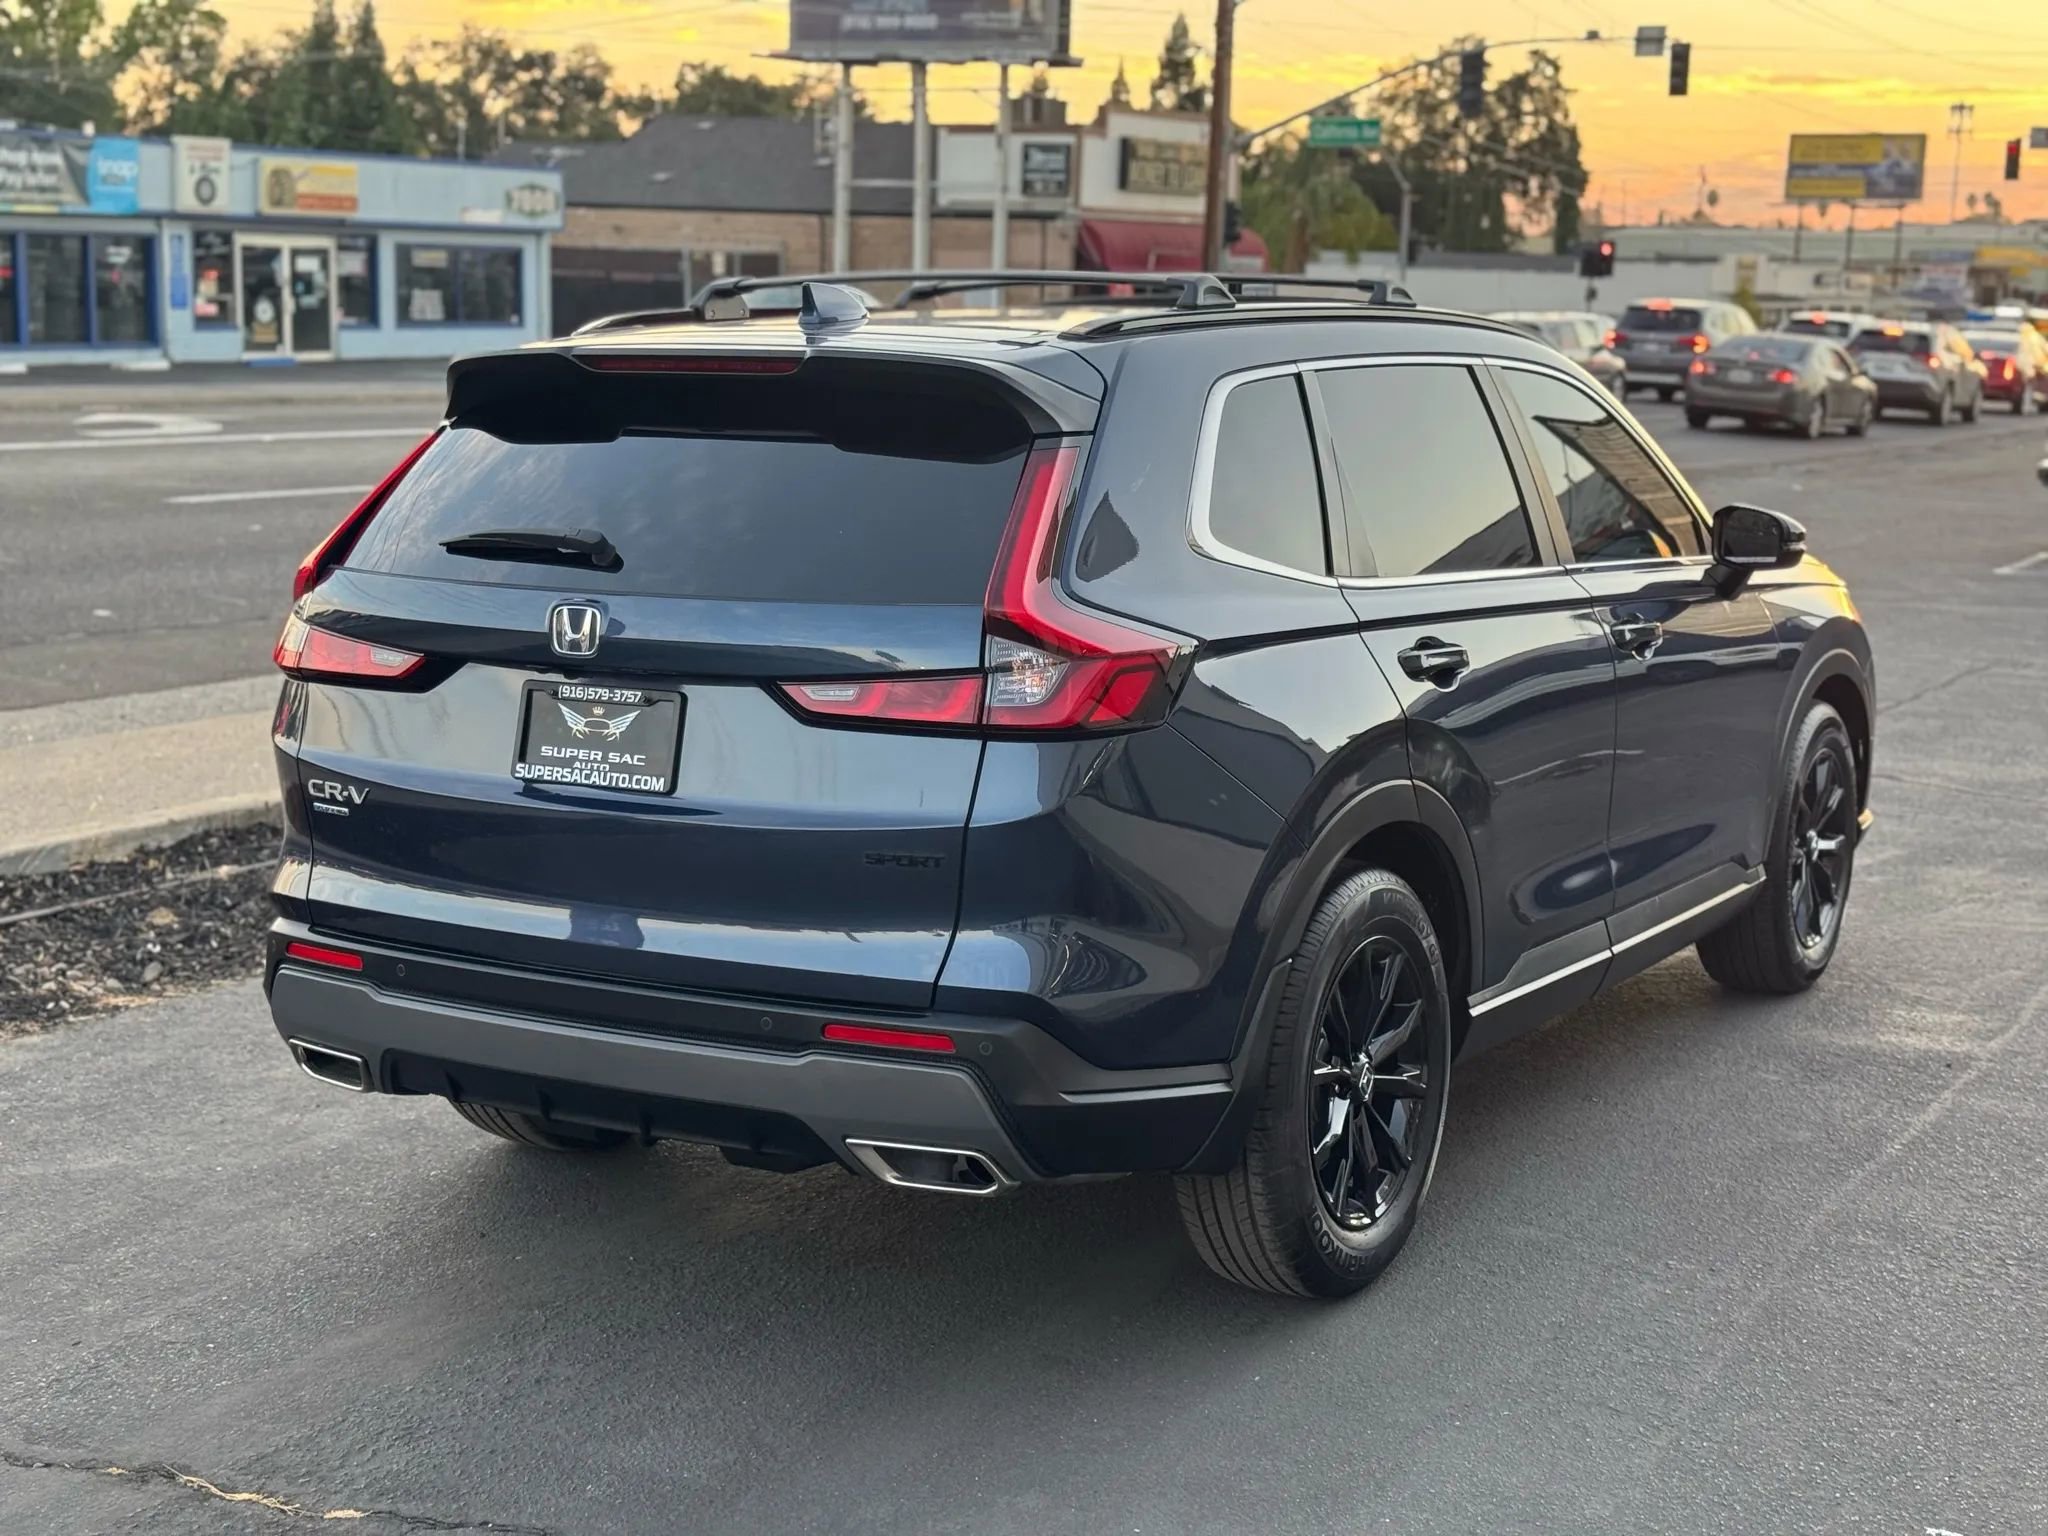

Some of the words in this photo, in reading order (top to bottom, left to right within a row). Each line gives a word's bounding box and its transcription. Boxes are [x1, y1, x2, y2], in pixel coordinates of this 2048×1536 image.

[558, 685, 642, 703] (916)579-3757
[540, 746, 603, 762] SUPER
[608, 752, 647, 766] SAC
[573, 761, 610, 772] AUTO
[514, 763, 666, 792] SUPERSACAUTO.COM
[307, 778, 370, 805] CR-V
[864, 851, 945, 868] SPORT
